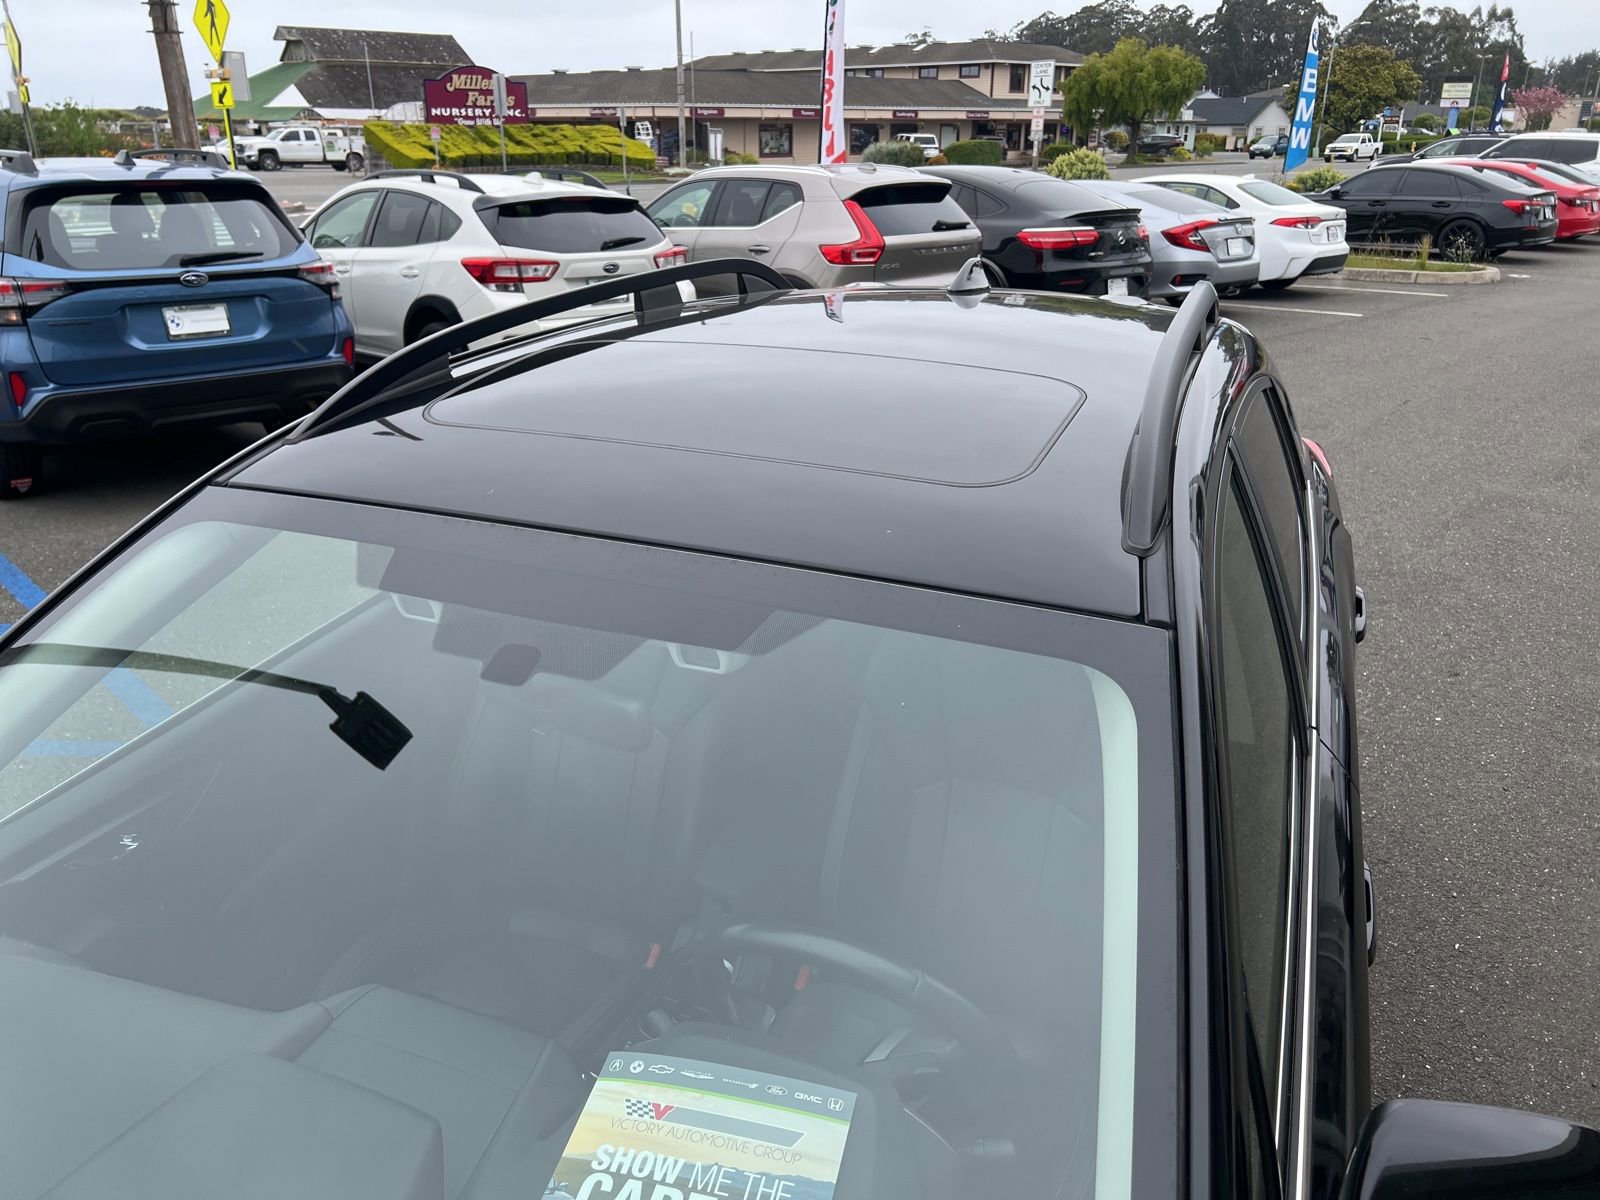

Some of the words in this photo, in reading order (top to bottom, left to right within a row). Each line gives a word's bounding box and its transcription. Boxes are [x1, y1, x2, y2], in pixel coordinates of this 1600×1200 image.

[465, 91, 516, 107] Fars
[504, 108, 526, 117] NC.
[1291, 68, 1318, 149] BMW
[794, 1092, 823, 1104] GMC
[611, 1118, 664, 1135] VICTORY
[665, 1127, 751, 1154] AUTOMOTIVE
[753, 1144, 802, 1165] GROUP
[591, 1143, 686, 1184] SHOW
[688, 1161, 736, 1197] ME
[743, 1171, 796, 1200] THE
